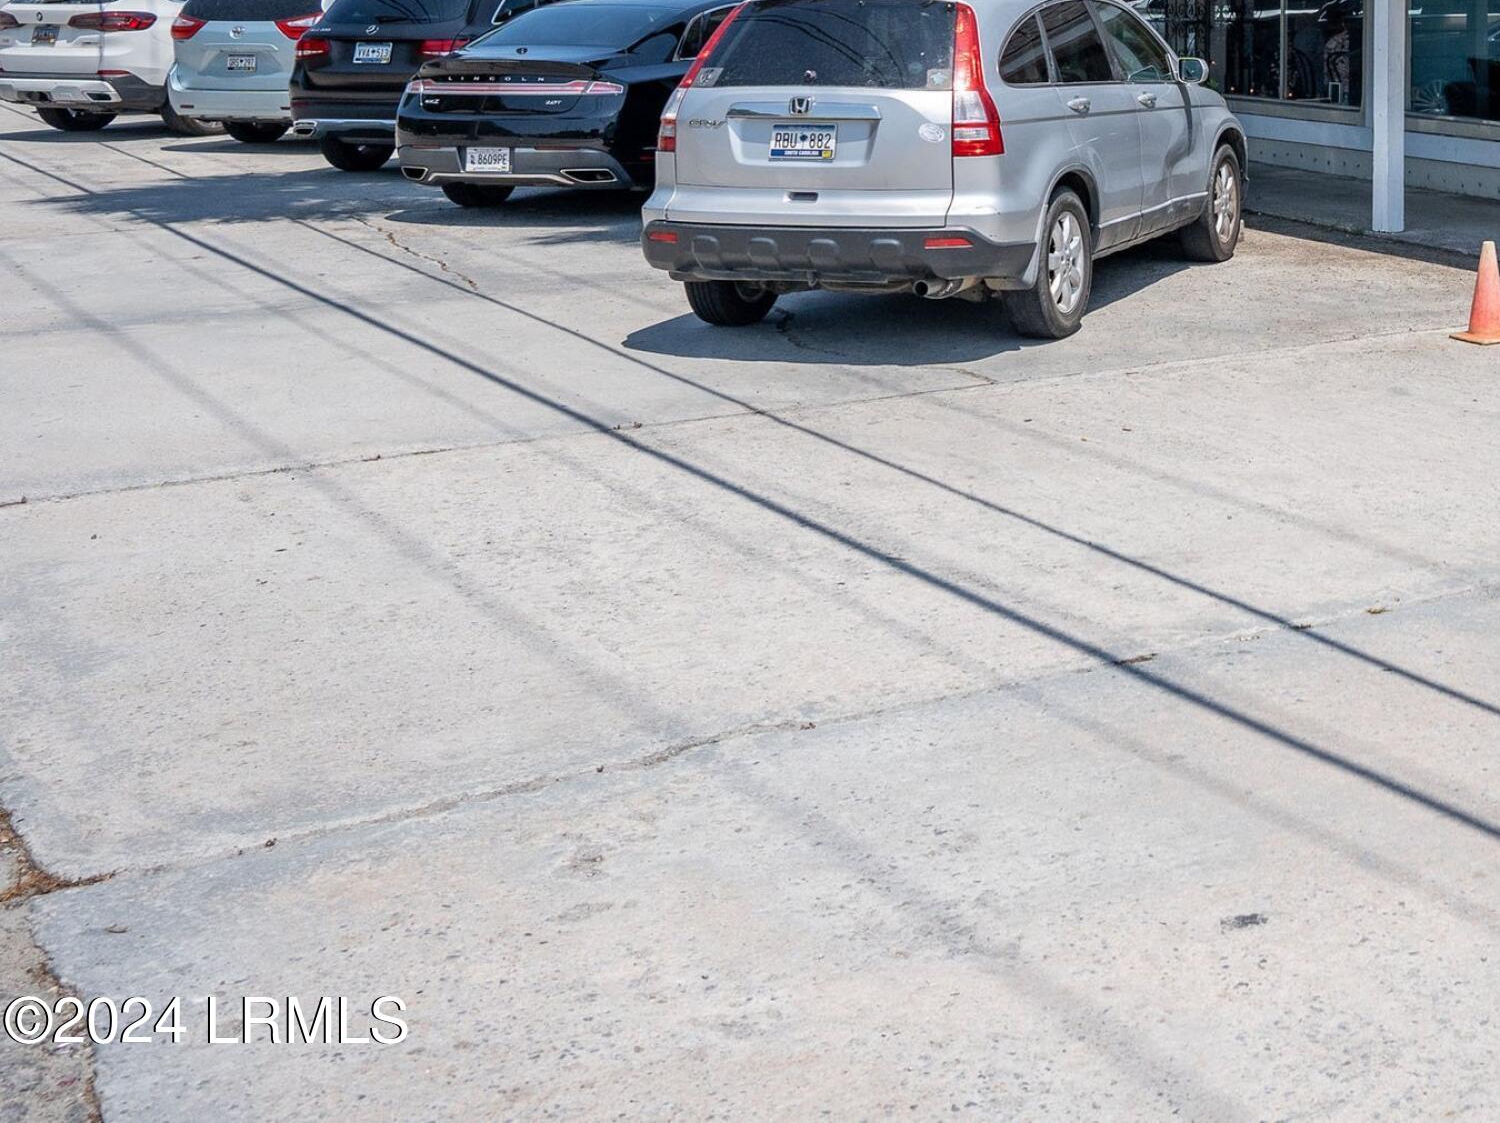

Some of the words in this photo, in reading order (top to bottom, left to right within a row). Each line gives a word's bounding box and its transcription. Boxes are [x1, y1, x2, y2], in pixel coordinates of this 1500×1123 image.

[774, 131, 798, 149] RBU
[808, 132, 832, 149] 882
[477, 154, 508, 165] 8609PE
